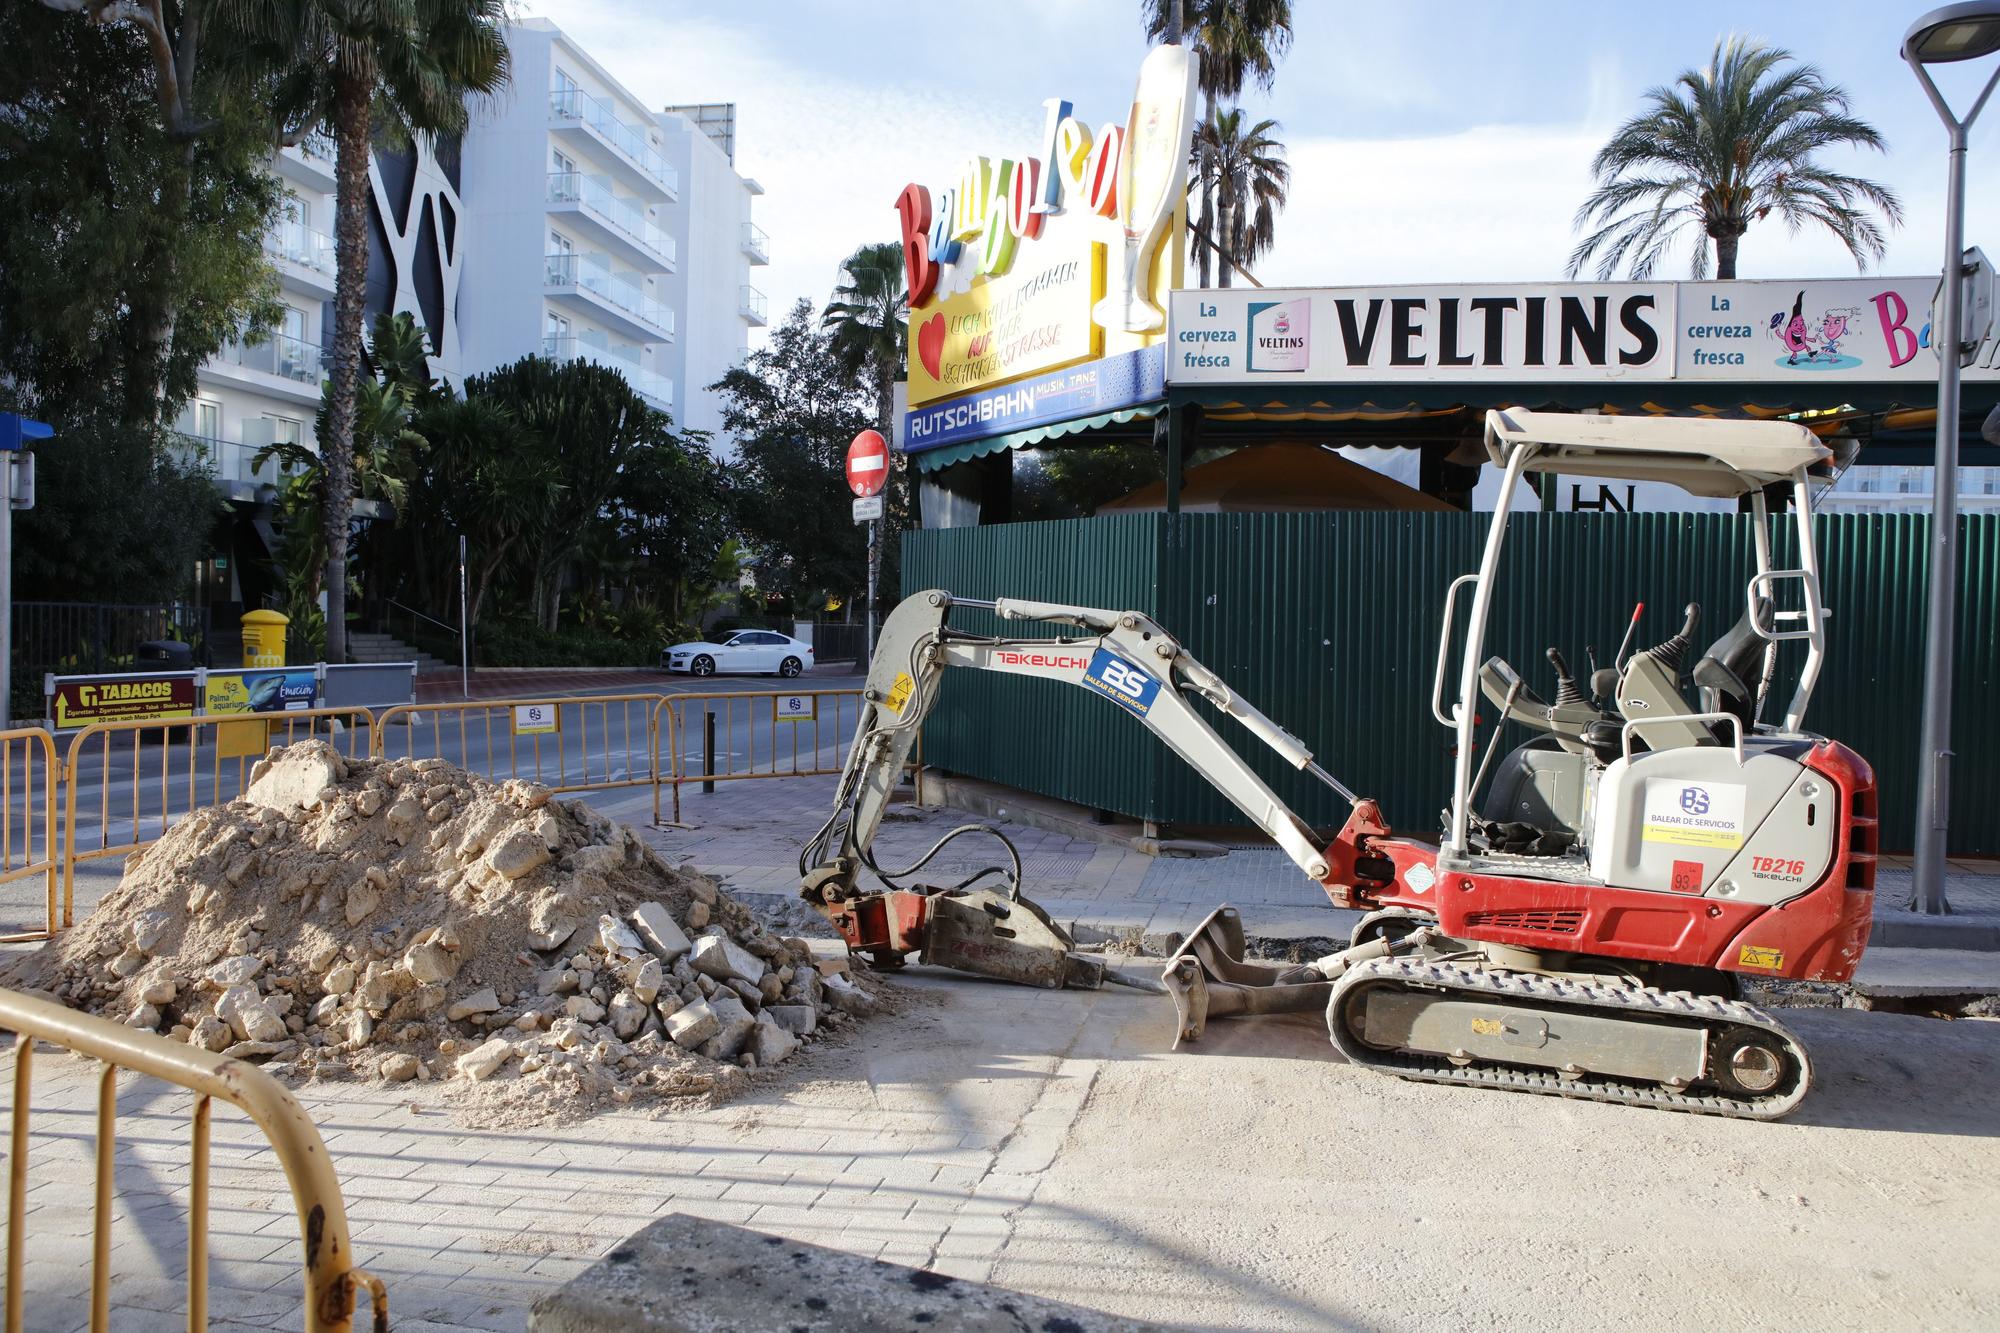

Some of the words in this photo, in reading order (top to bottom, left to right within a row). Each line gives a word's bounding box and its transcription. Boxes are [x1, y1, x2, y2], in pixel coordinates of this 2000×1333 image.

[894, 97, 1124, 308] Bamboleo
[1200, 302, 1217, 318] La
[1711, 295, 1730, 312] La
[1179, 328, 1237, 343] cerveza
[1334, 295, 1659, 367] VELTINS
[1688, 325, 1752, 338] cerveza
[1259, 337, 1304, 349] VELTINS
[1184, 352, 1230, 367] fresca
[1693, 348, 1745, 365] fresca
[1036, 378, 1064, 395] MUSIK
[1070, 370, 1096, 387] TANZ
[911, 386, 1034, 438] RUTSCHBAHN
[1101, 660, 1150, 698] BS
[101, 681, 172, 700] TABACOS
[210, 694, 229, 703] Palma
[1085, 675, 1108, 691] BALEAR
[1108, 688, 1117, 696] DE
[1116, 692, 1148, 713] SERVICIOS
[213, 701, 244, 711] aquarium
[790, 698, 801, 710] BS
[530, 708, 541, 720] BS
[1681, 788, 1709, 814] BS
[1651, 815, 1681, 824] BALEAR
[1695, 819, 1735, 829] SERVICIOS
[1752, 856, 1805, 875] TB216
[1675, 873, 1690, 890] 93
